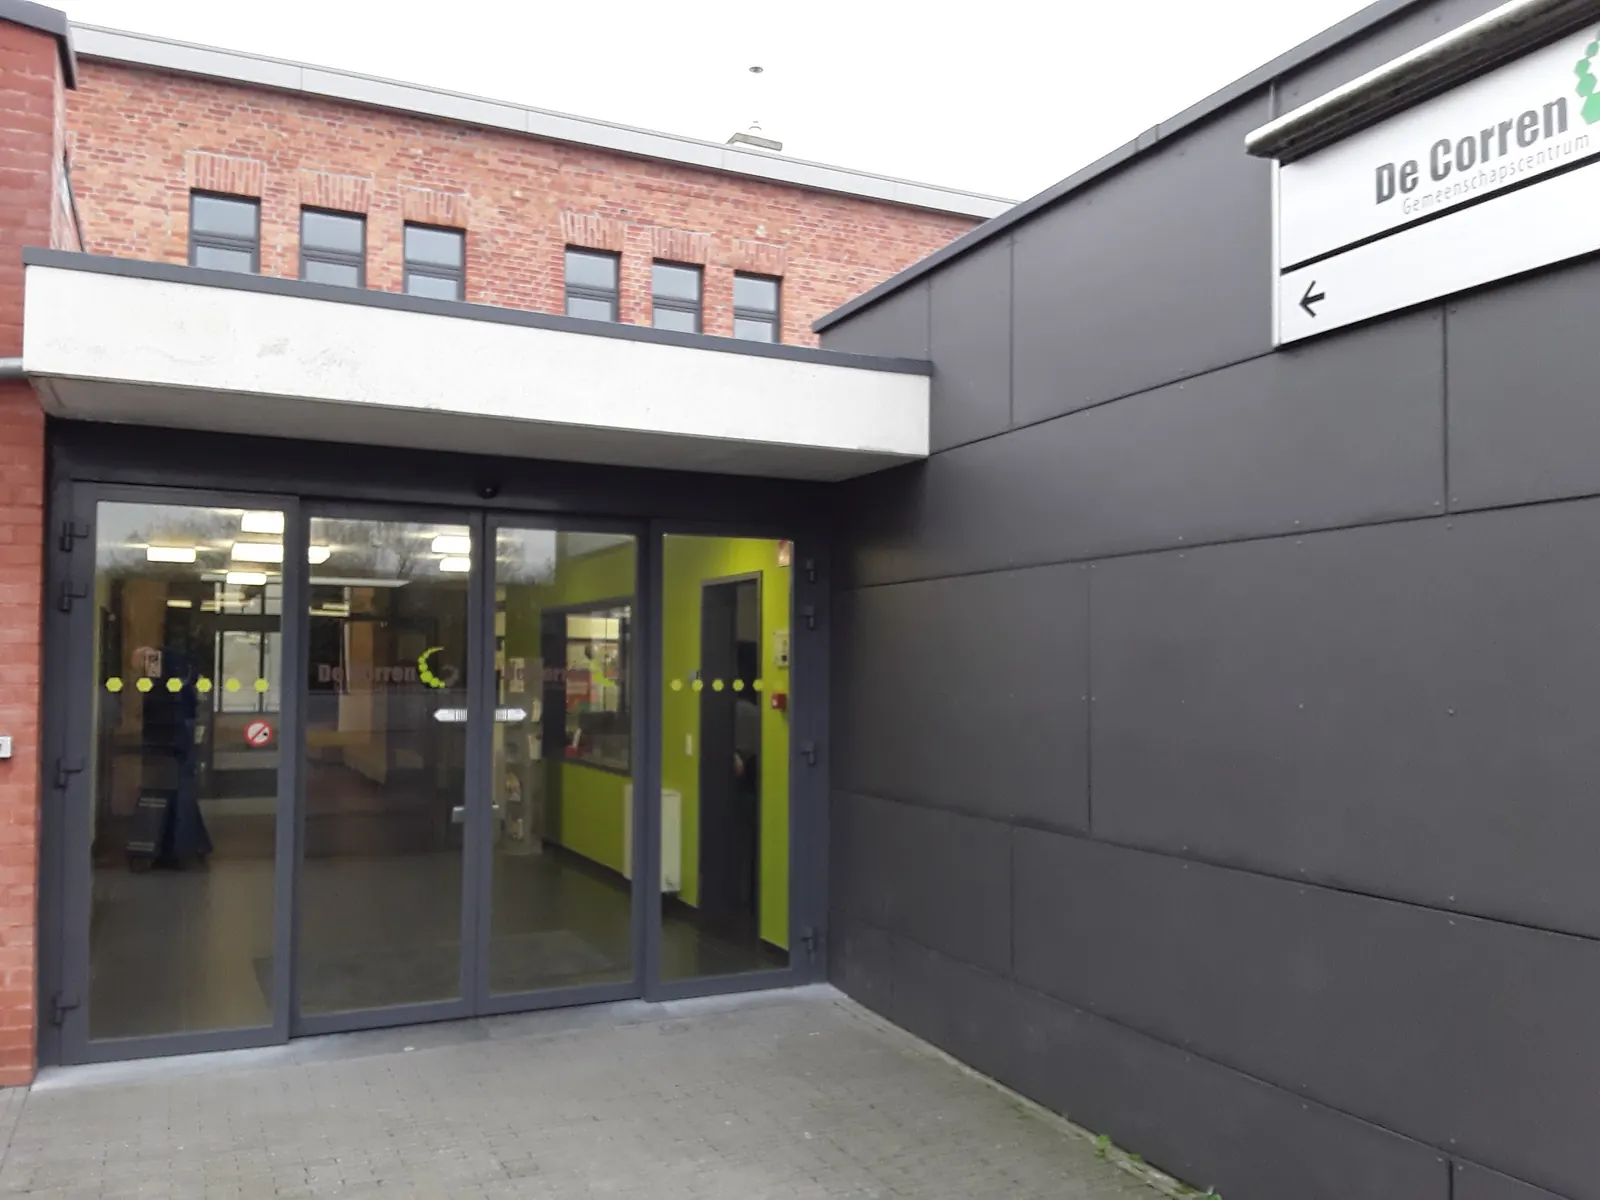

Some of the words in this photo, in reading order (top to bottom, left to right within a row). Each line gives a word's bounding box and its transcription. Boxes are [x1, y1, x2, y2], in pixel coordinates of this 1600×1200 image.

[1375, 160, 1419, 205] De
[1430, 96, 1569, 182] Corren
[1403, 133, 1590, 215] Gemeenschapscentrum
